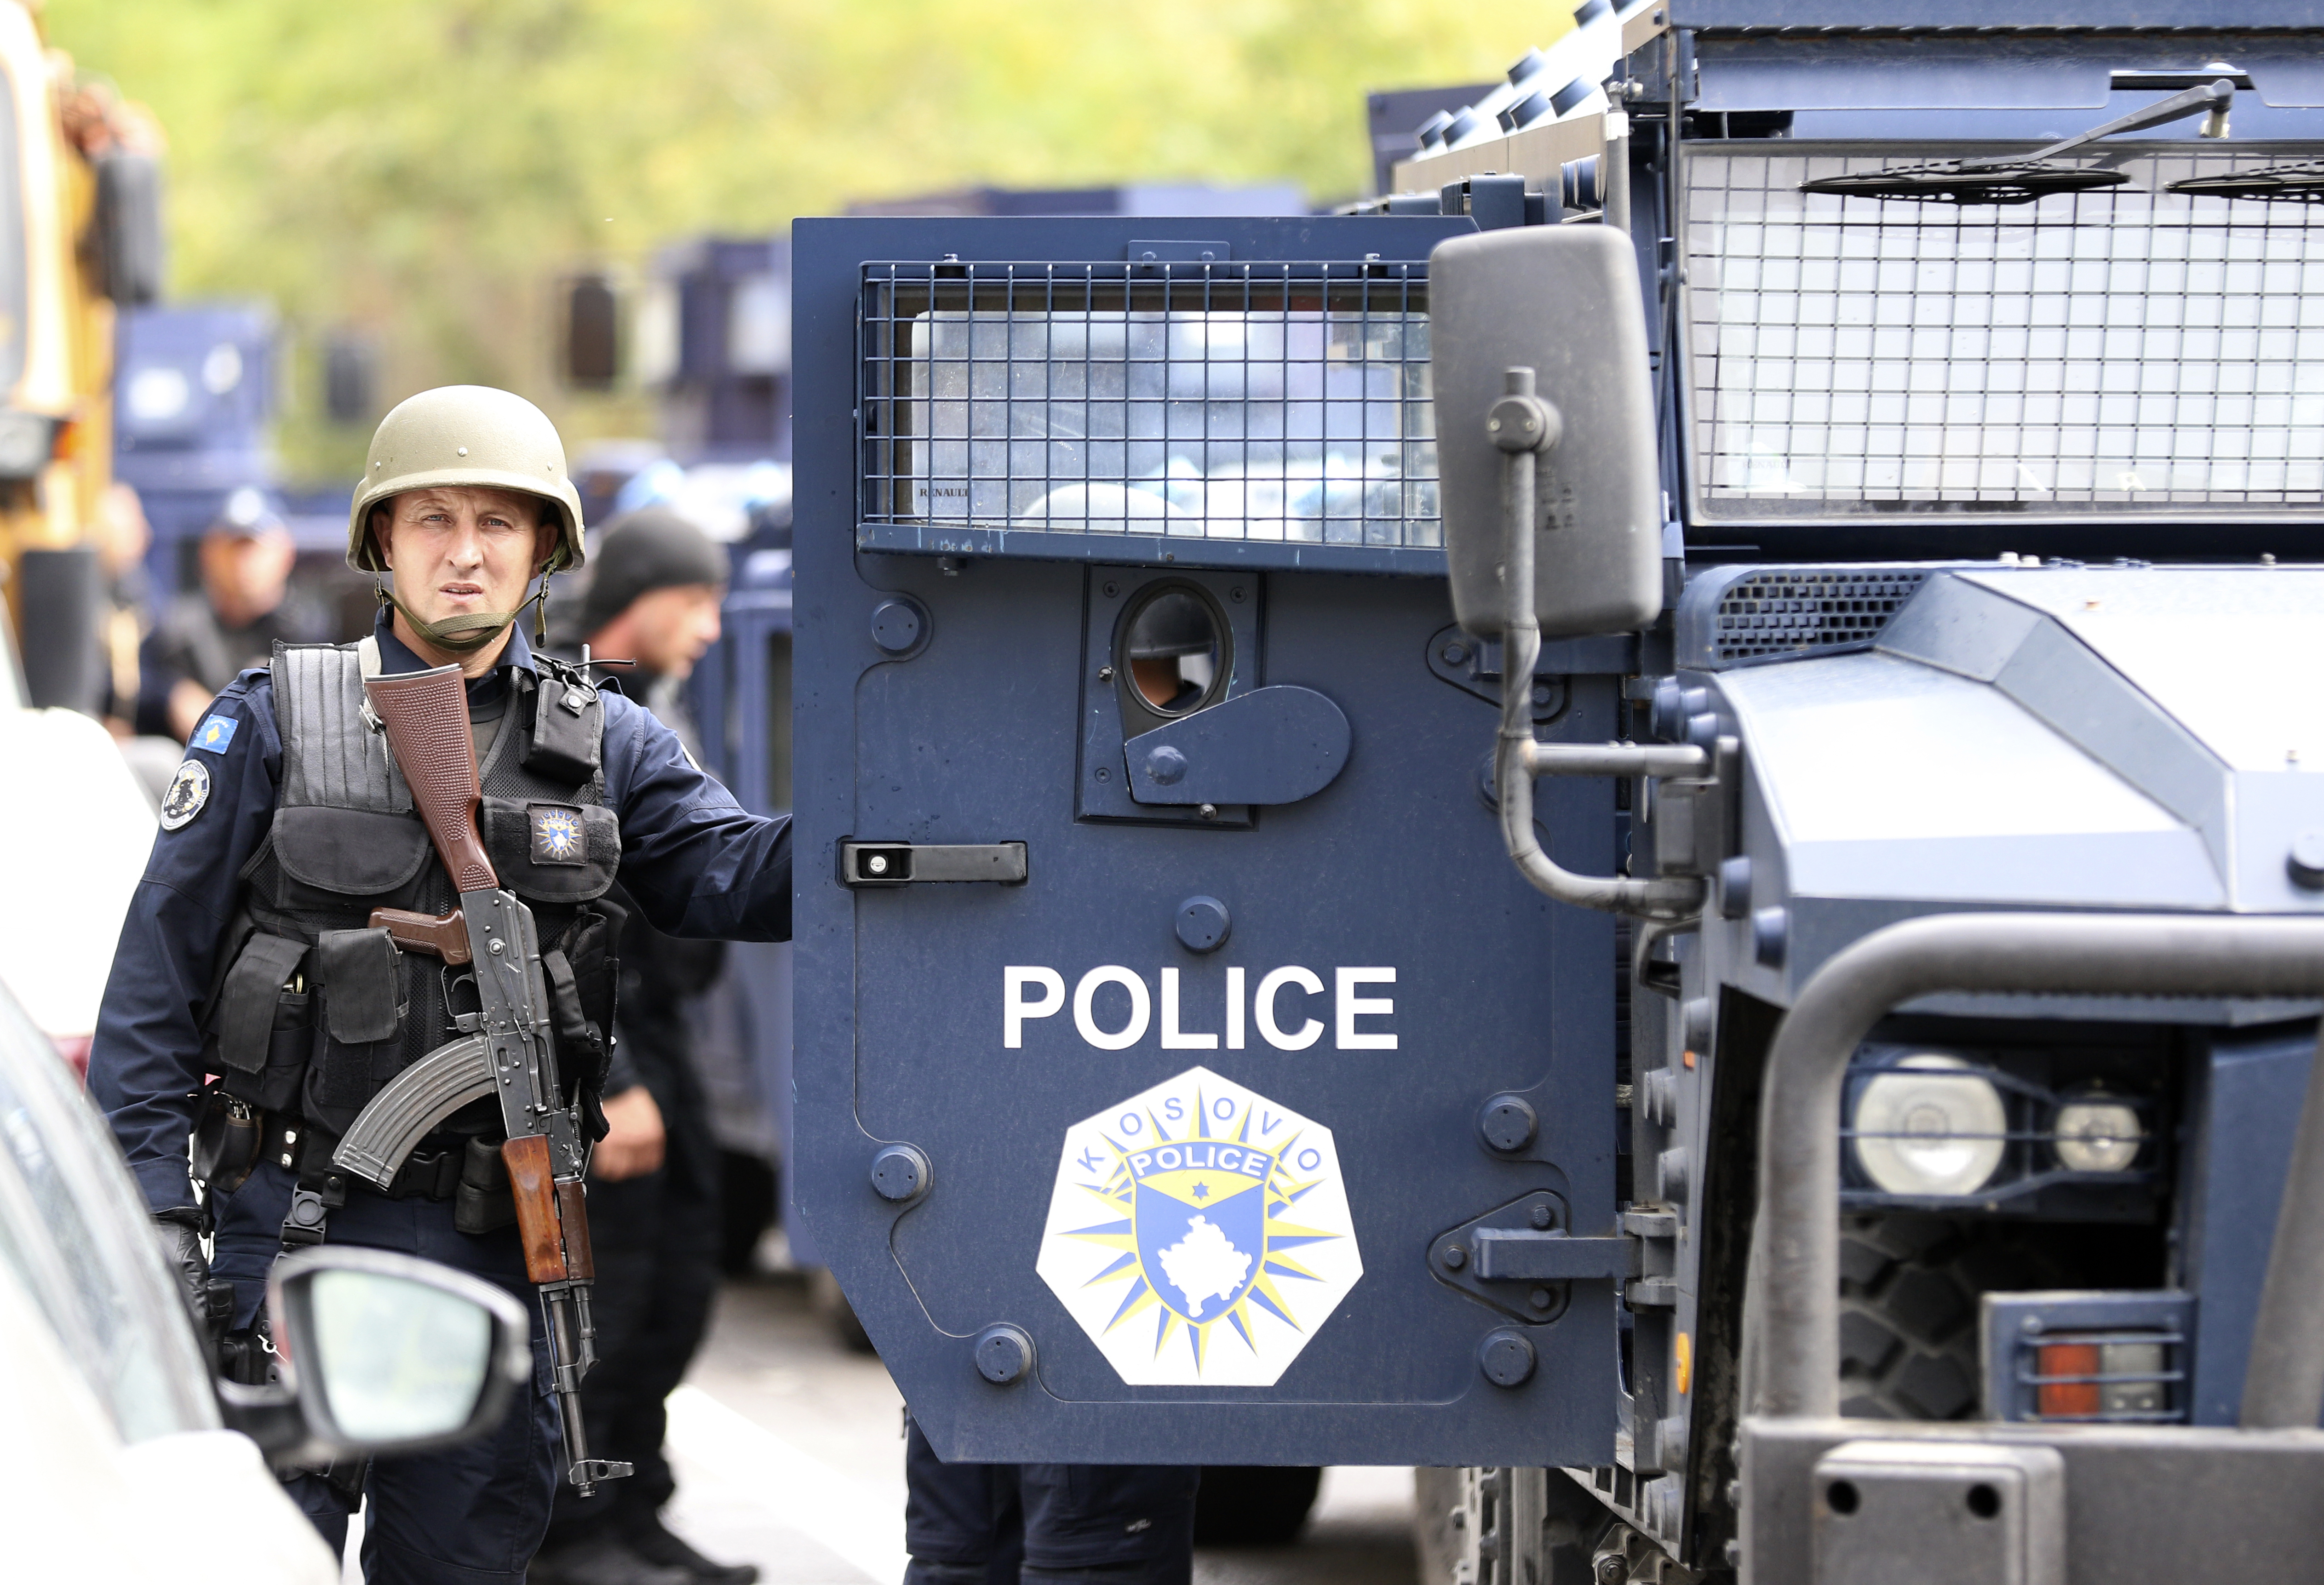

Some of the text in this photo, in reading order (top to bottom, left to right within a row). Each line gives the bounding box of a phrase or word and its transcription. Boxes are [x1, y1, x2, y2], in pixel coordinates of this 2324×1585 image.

[197, 789, 207, 806] UNIT
[539, 810, 579, 826] KOSOVO
[1004, 964, 1399, 1051] POLICE
[1077, 1097, 1322, 1174] KOSOVO
[1130, 1146, 1268, 1177] POLICE
